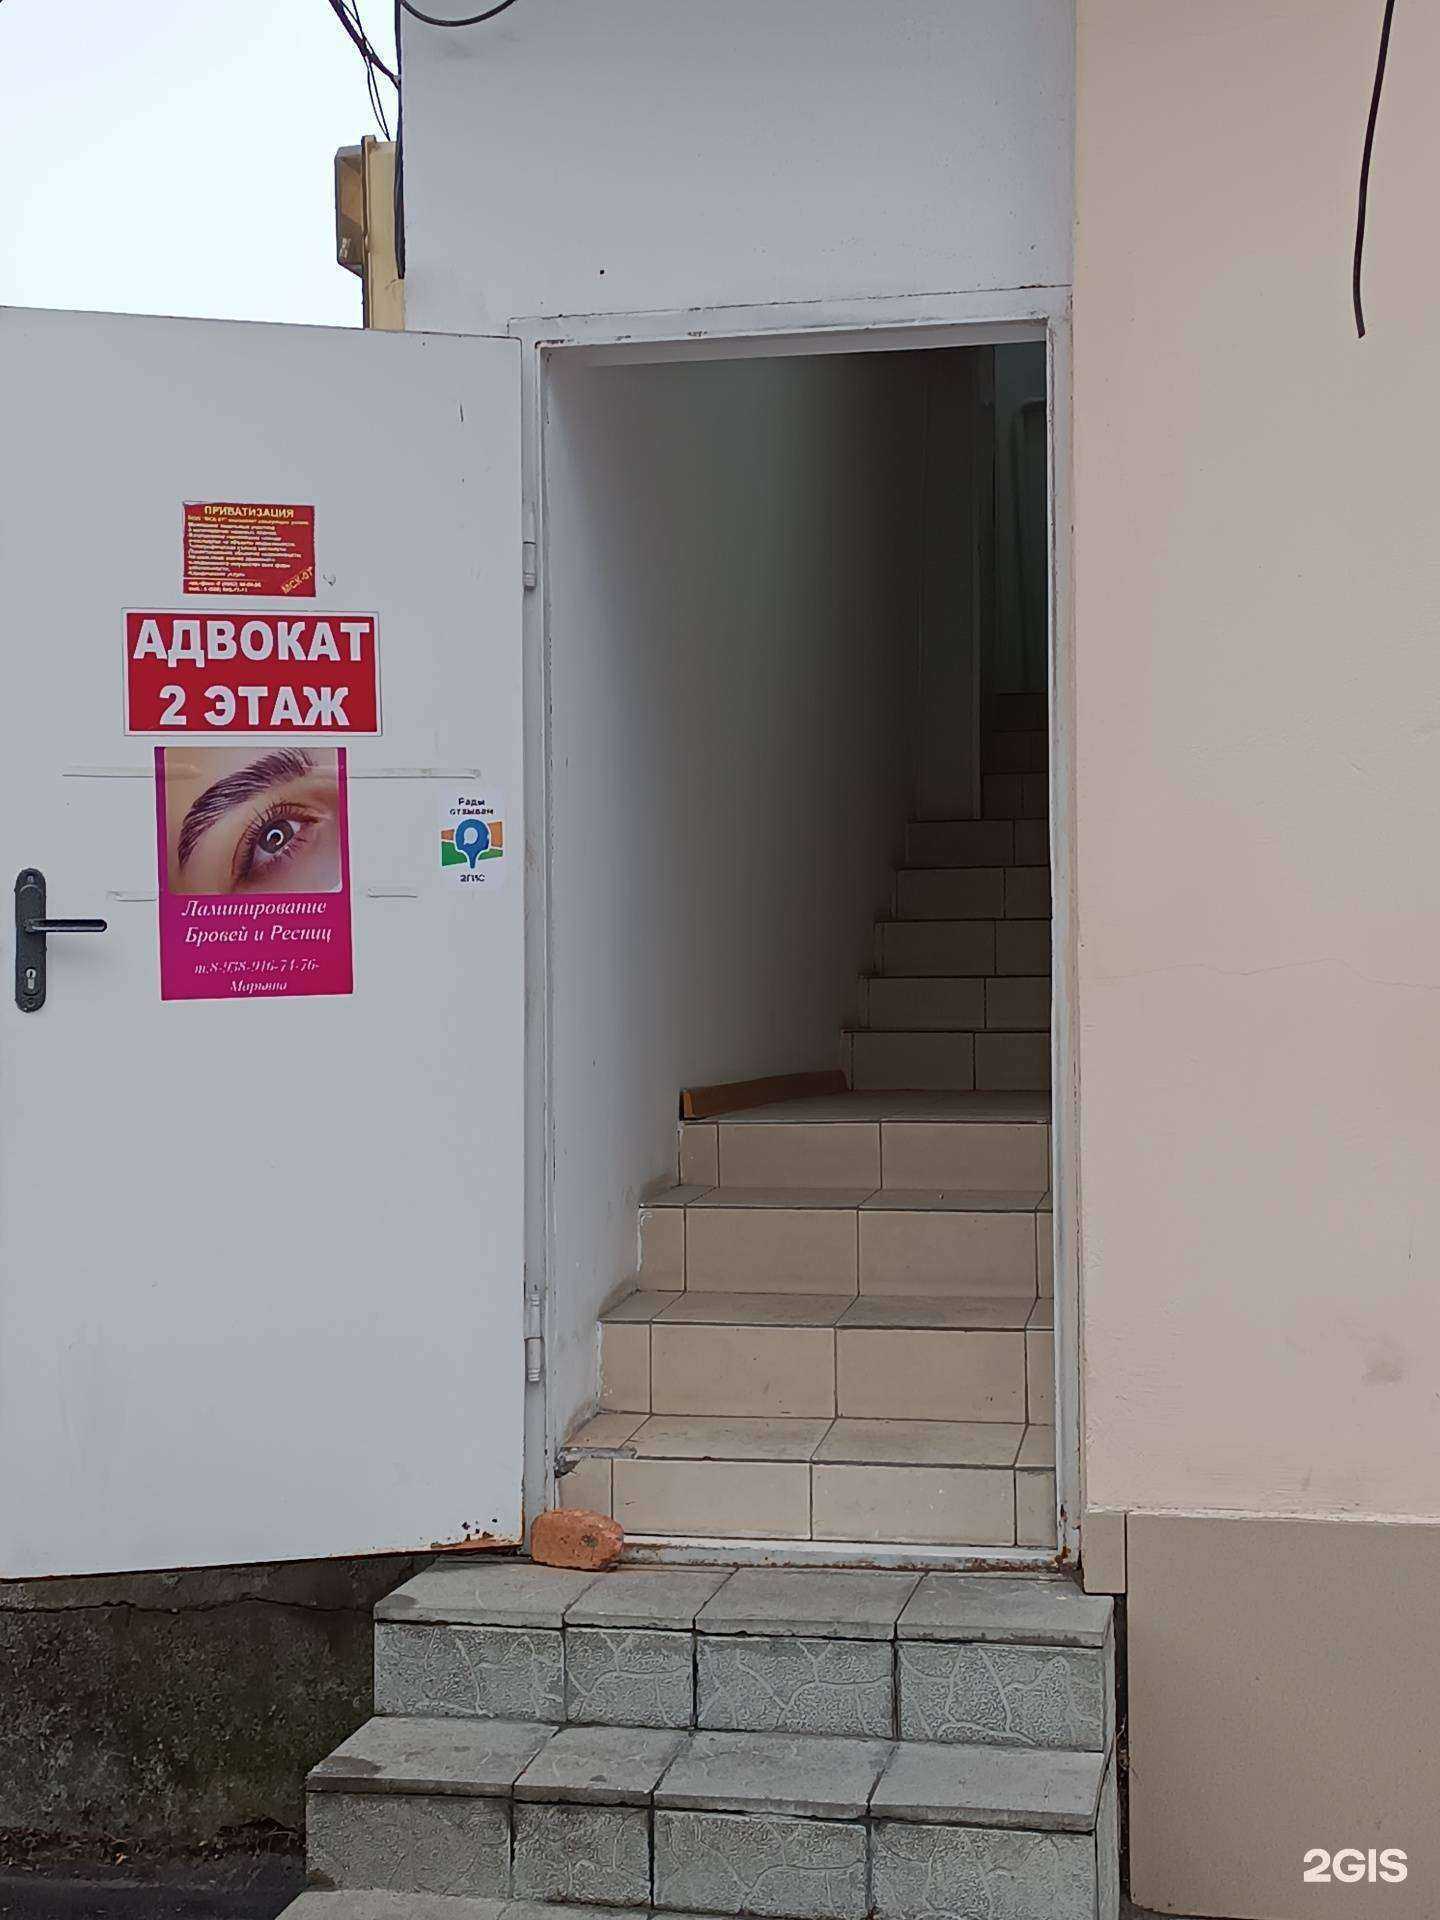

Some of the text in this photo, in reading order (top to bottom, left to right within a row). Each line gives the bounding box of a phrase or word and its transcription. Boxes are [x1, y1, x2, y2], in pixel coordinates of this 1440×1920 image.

[204, 505, 294, 518] ПРИВАТИЗАЦИЯ
[133, 619, 370, 668] АДВОКАТ
[159, 685, 350, 726] 2 ЭТАЖ
[181, 900, 327, 920] Ламинирование
[185, 925, 332, 948] Бровей и Ресниц
